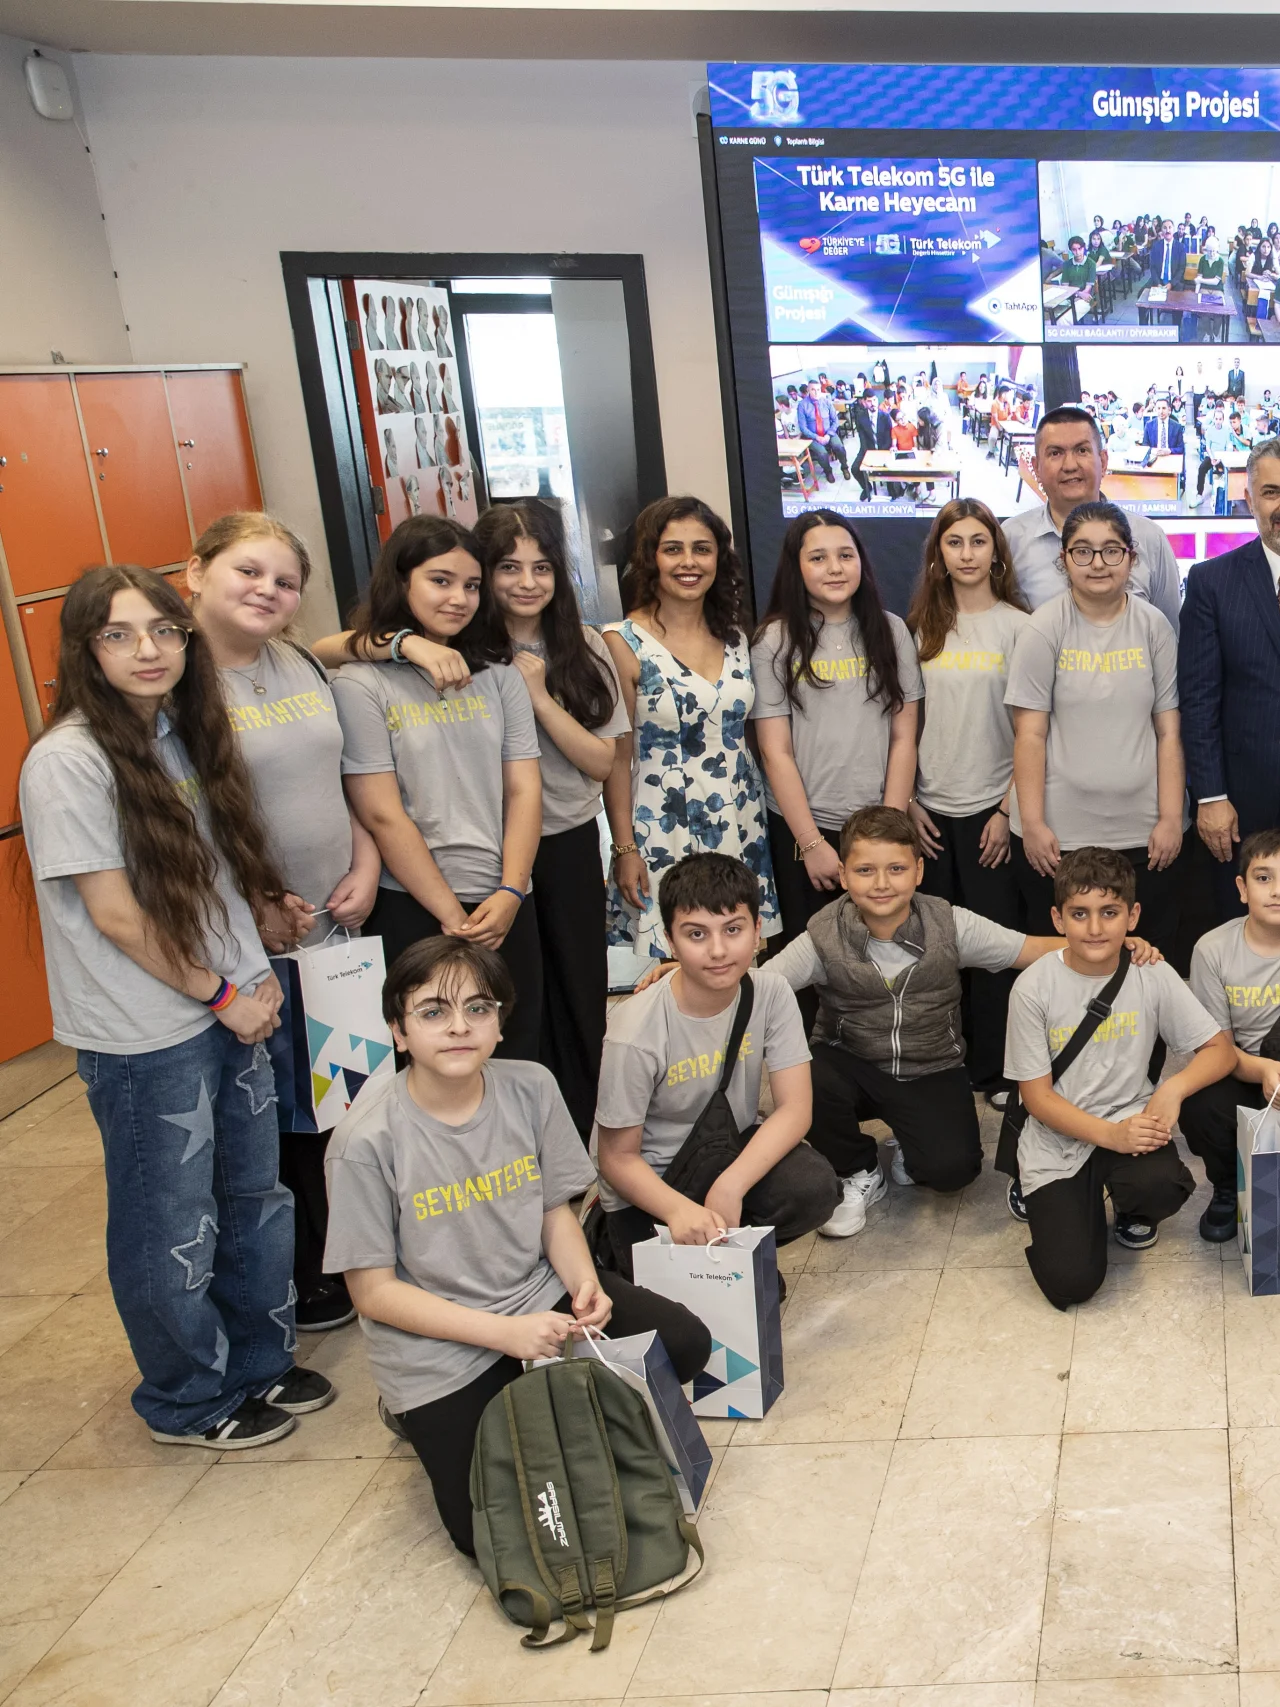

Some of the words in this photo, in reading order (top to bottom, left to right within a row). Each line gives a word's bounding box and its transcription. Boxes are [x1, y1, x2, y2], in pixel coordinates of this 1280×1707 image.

[750, 70, 799, 120] 5G
[1092, 89, 1180, 124] Günışığı
[1186, 90, 1259, 124] Projesi
[797, 166, 844, 186] Türk
[847, 166, 933, 187] Telekom
[938, 167, 966, 187] 5G
[970, 167, 995, 187] ile
[819, 191, 879, 212] Karne
[884, 192, 976, 216] Heyecanı
[822, 236, 865, 247] TÜRKİYE'YE
[910, 238, 933, 250] Türk
[936, 238, 982, 250] Telekom
[824, 245, 848, 255] DEĞER
[774, 305, 827, 322] Projesi
[1047, 329, 1058, 337] 5G
[1059, 329, 1084, 337] CANLI
[1084, 328, 1125, 337] BAĞLANTI
[1130, 328, 1177, 337] DİYARBAKIR
[786, 505, 798, 514] 5G
[800, 505, 828, 513] CAN
[882, 505, 914, 514] KONYA
[1142, 504, 1177, 512] SAMSUN
[1059, 648, 1146, 673] SEYRANTEPE
[227, 691, 331, 732] EYRANTEPE
[340, 967, 363, 977] Telekom
[413, 1155, 540, 1220] SEYRANTEPE
[706, 1273, 733, 1281] Telekom
